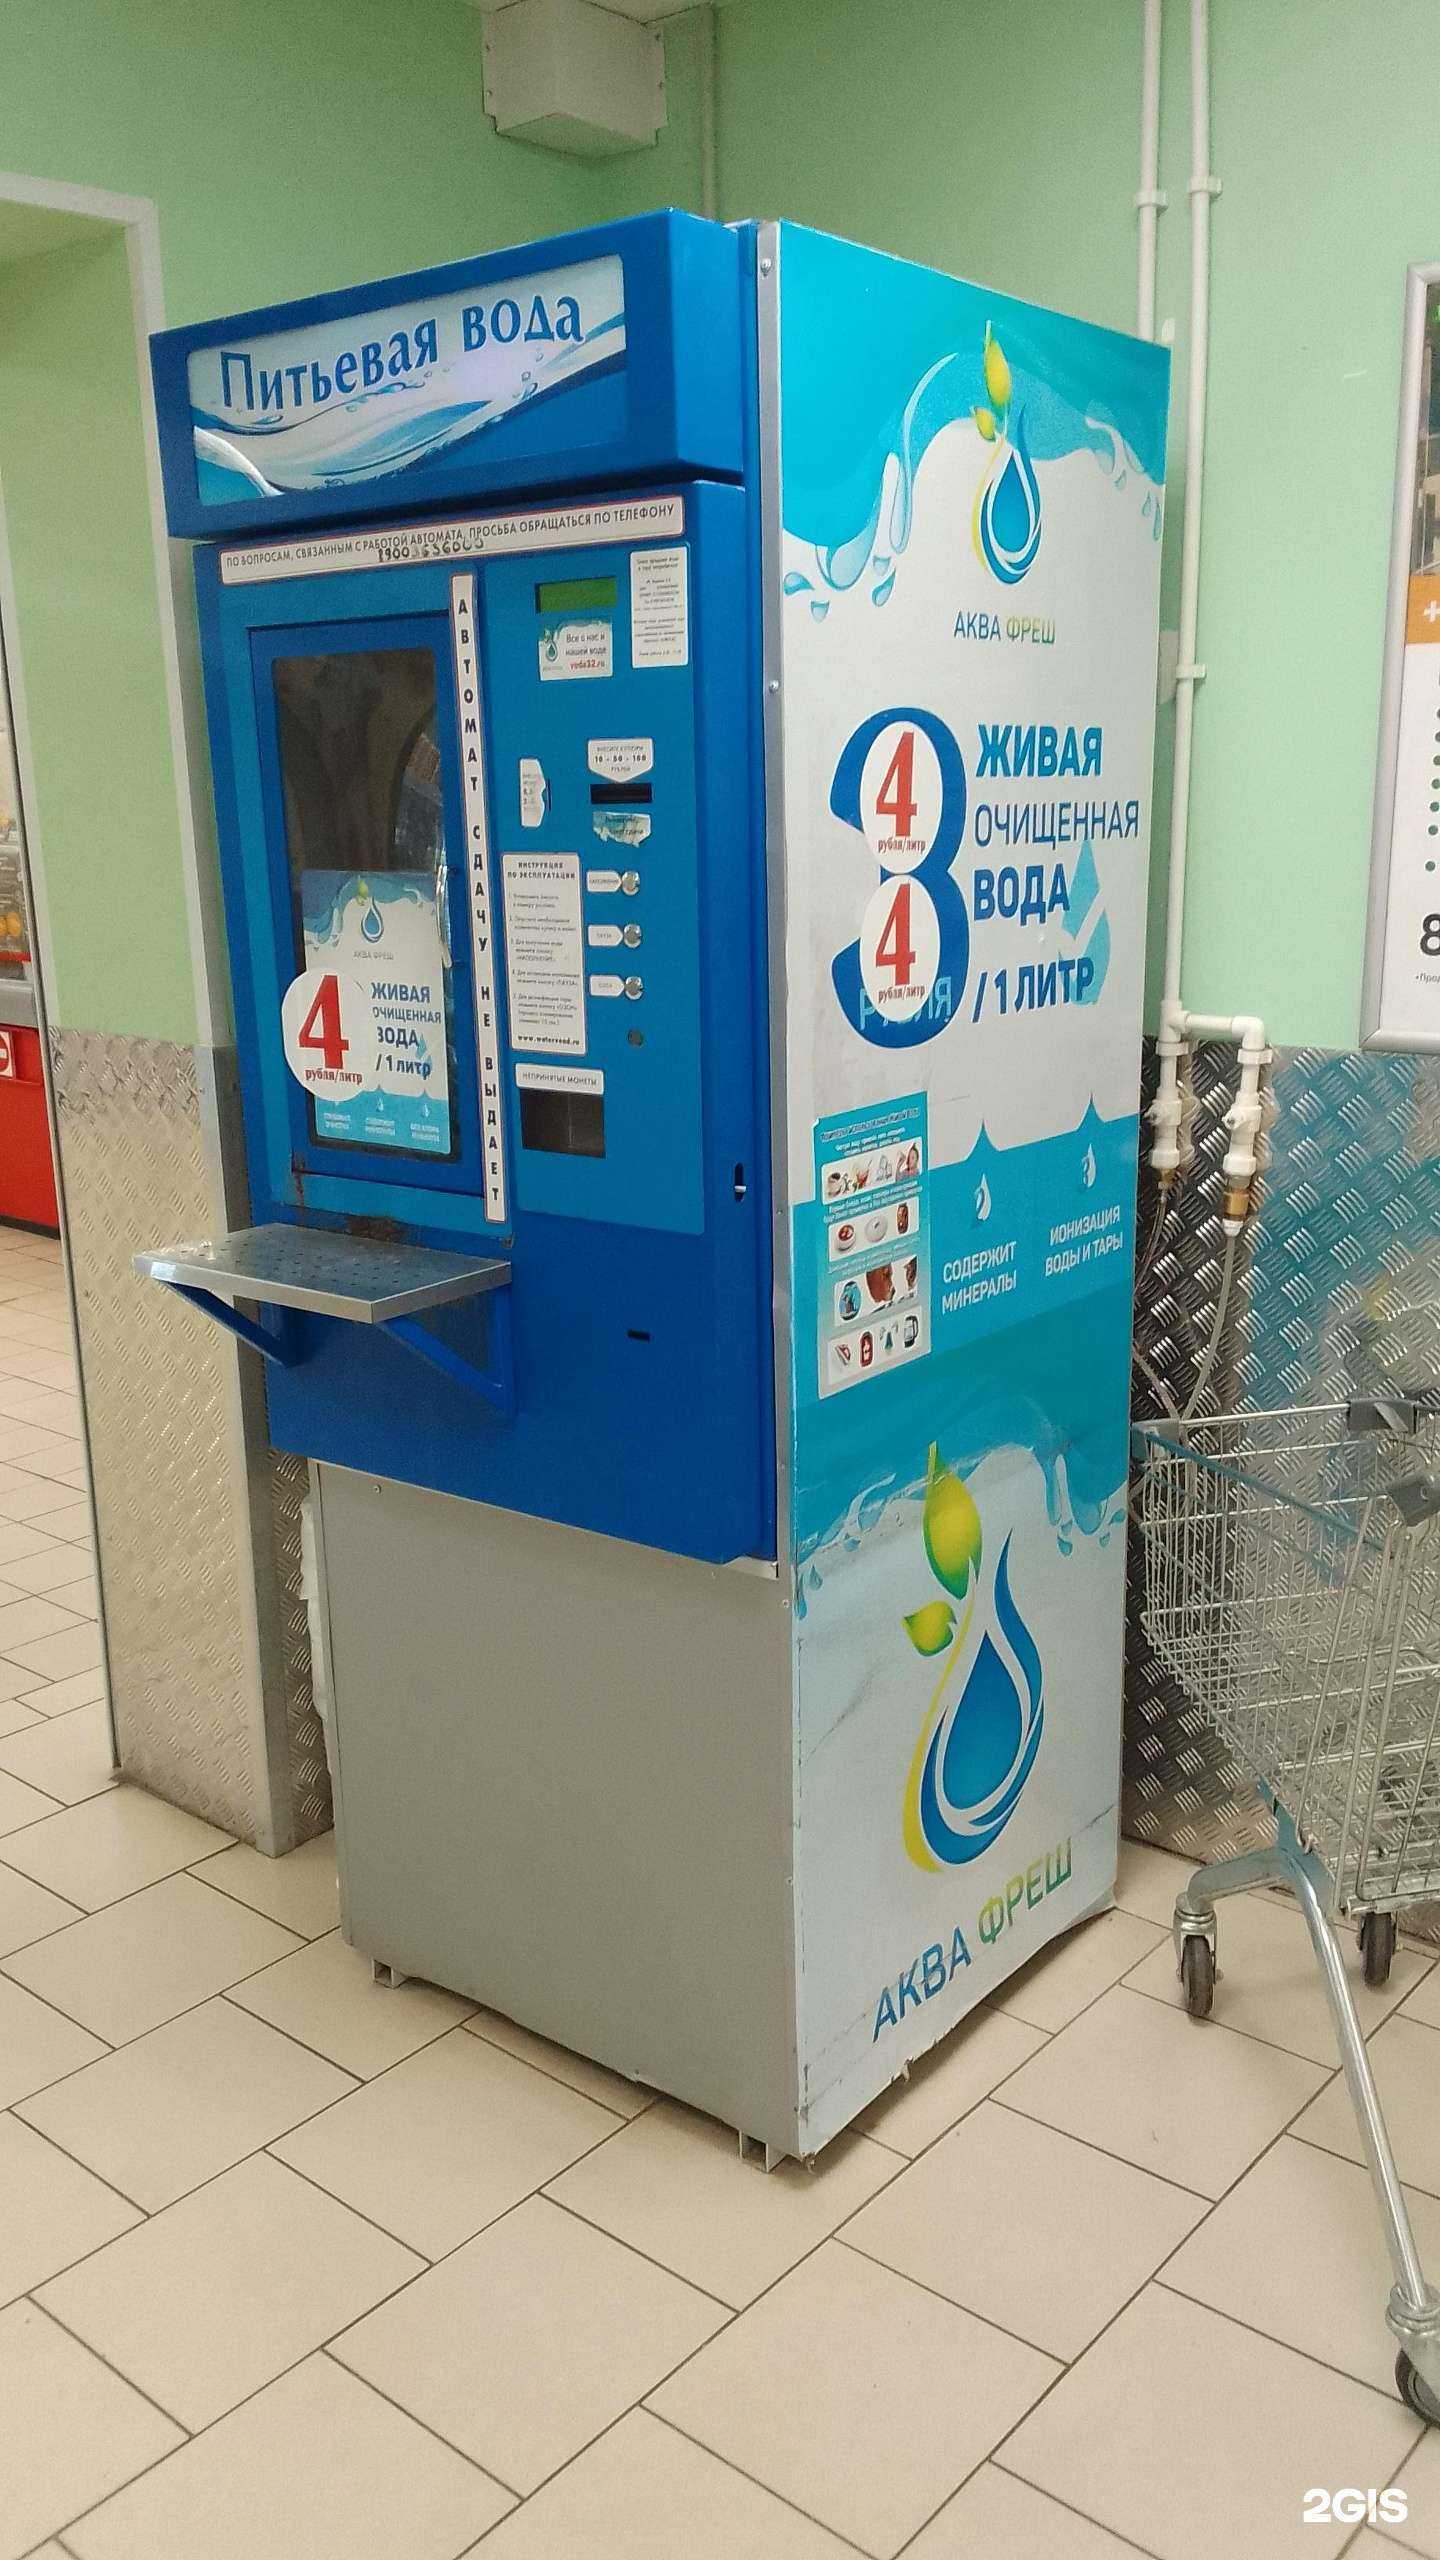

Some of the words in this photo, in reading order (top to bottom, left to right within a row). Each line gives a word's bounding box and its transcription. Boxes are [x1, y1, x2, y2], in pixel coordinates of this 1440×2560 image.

[220, 317, 438, 411] Питьевая
[462, 295, 583, 352] вода
[226, 556, 240, 567] ПО
[241, 552, 294, 566] ВОПРОСАМ,
[296, 543, 352, 559] СВЯЗАННЫМ
[362, 533, 408, 551] РАБОТОЙ
[470, 522, 517, 539] ПРОСЬБА
[519, 513, 592, 532] ОБРАЩАТЬСЯ
[594, 512, 611, 525] ПО
[614, 504, 675, 522] ТЕЛЕФОНУ
[953, 610, 1001, 640] АКВА
[1005, 614, 1056, 645] ФРЕШ
[458, 599, 478, 791] АВТОМАТ
[975, 724, 1103, 778] ЖИВАЯ
[875, 728, 918, 837] 4
[974, 801, 1140, 850] ОЧИЩЕННАЯ
[472, 825, 488, 951] СДАЧУ
[974, 863, 1071, 926] ВОДА
[875, 880, 917, 986] 4
[371, 982, 431, 1003] ЖИВАЯ
[372, 1007, 442, 1024] ОЧИЩЕННАЯ
[481, 985, 491, 1027] НЕ
[298, 975, 349, 1069] 4
[484, 1056, 500, 1201] ВЫДАЕТ
[1045, 1250, 1081, 1277] ВОДЫ
[1082, 1245, 1092, 1262] И
[1093, 1231, 1124, 1260] ТАРЫ
[1050, 1205, 1121, 1246] ИОНИЗАЦИЯ
[942, 1241, 1017, 1283] СОДЕРЖИТ
[941, 1269, 1017, 1316] МИНЕРАЛЫ
[872, 1925, 973, 2044] АКВА
[977, 1837, 1072, 1945] ФРЕШ
